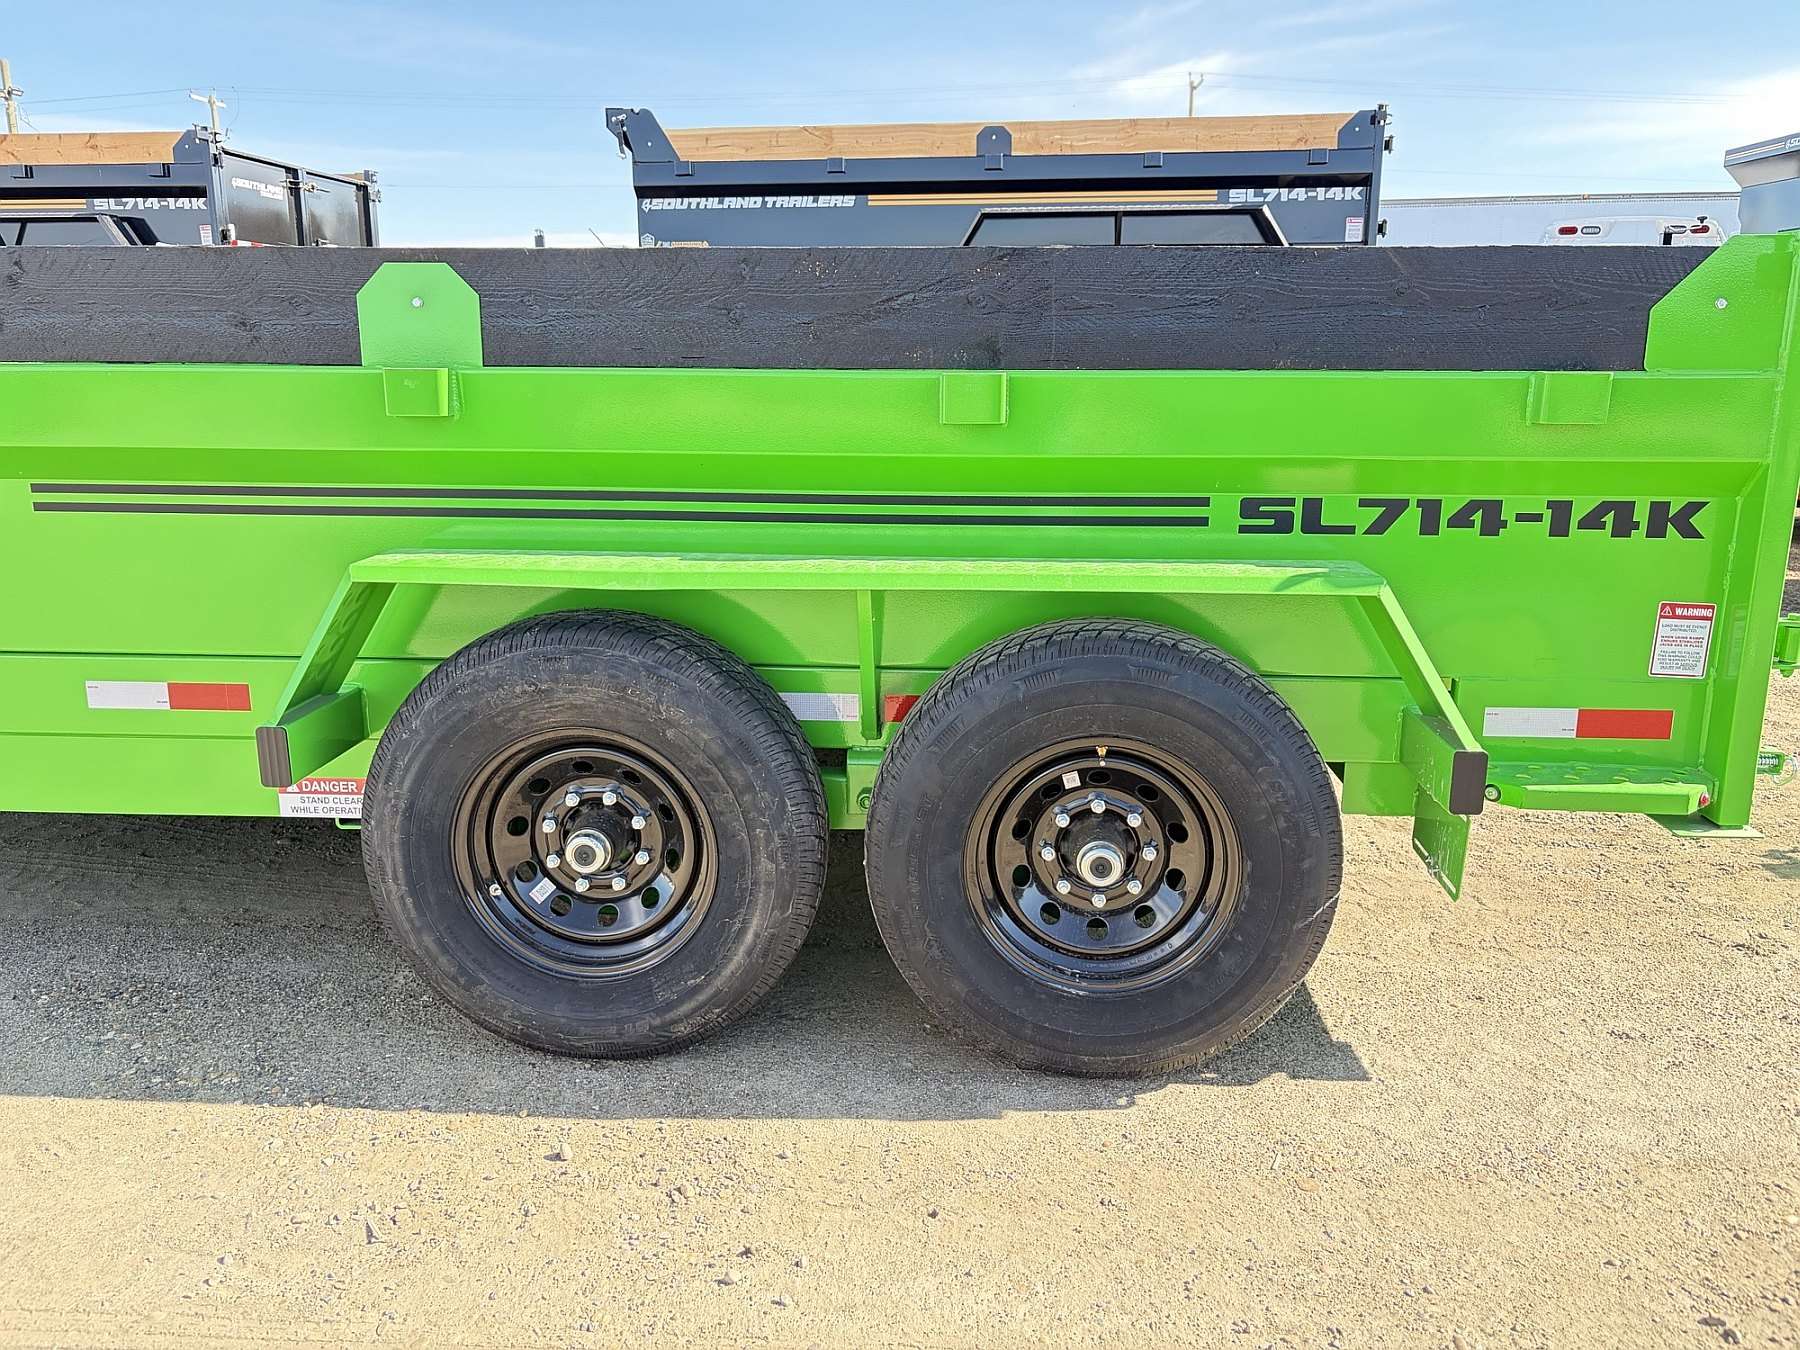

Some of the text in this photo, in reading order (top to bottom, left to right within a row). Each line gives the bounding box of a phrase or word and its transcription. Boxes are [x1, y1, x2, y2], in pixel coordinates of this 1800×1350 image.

[1229, 187, 1363, 203] SL714-14K
[94, 197, 208, 210] SL714-14K
[651, 195, 856, 210] SOUTHLAND TRAILERS
[1238, 496, 1712, 540] SL714-14K
[1675, 607, 1713, 617] WARNING
[301, 781, 357, 793] DANGER
[300, 796, 363, 805] STAND CLEAR
[291, 806, 319, 814] WHILE
